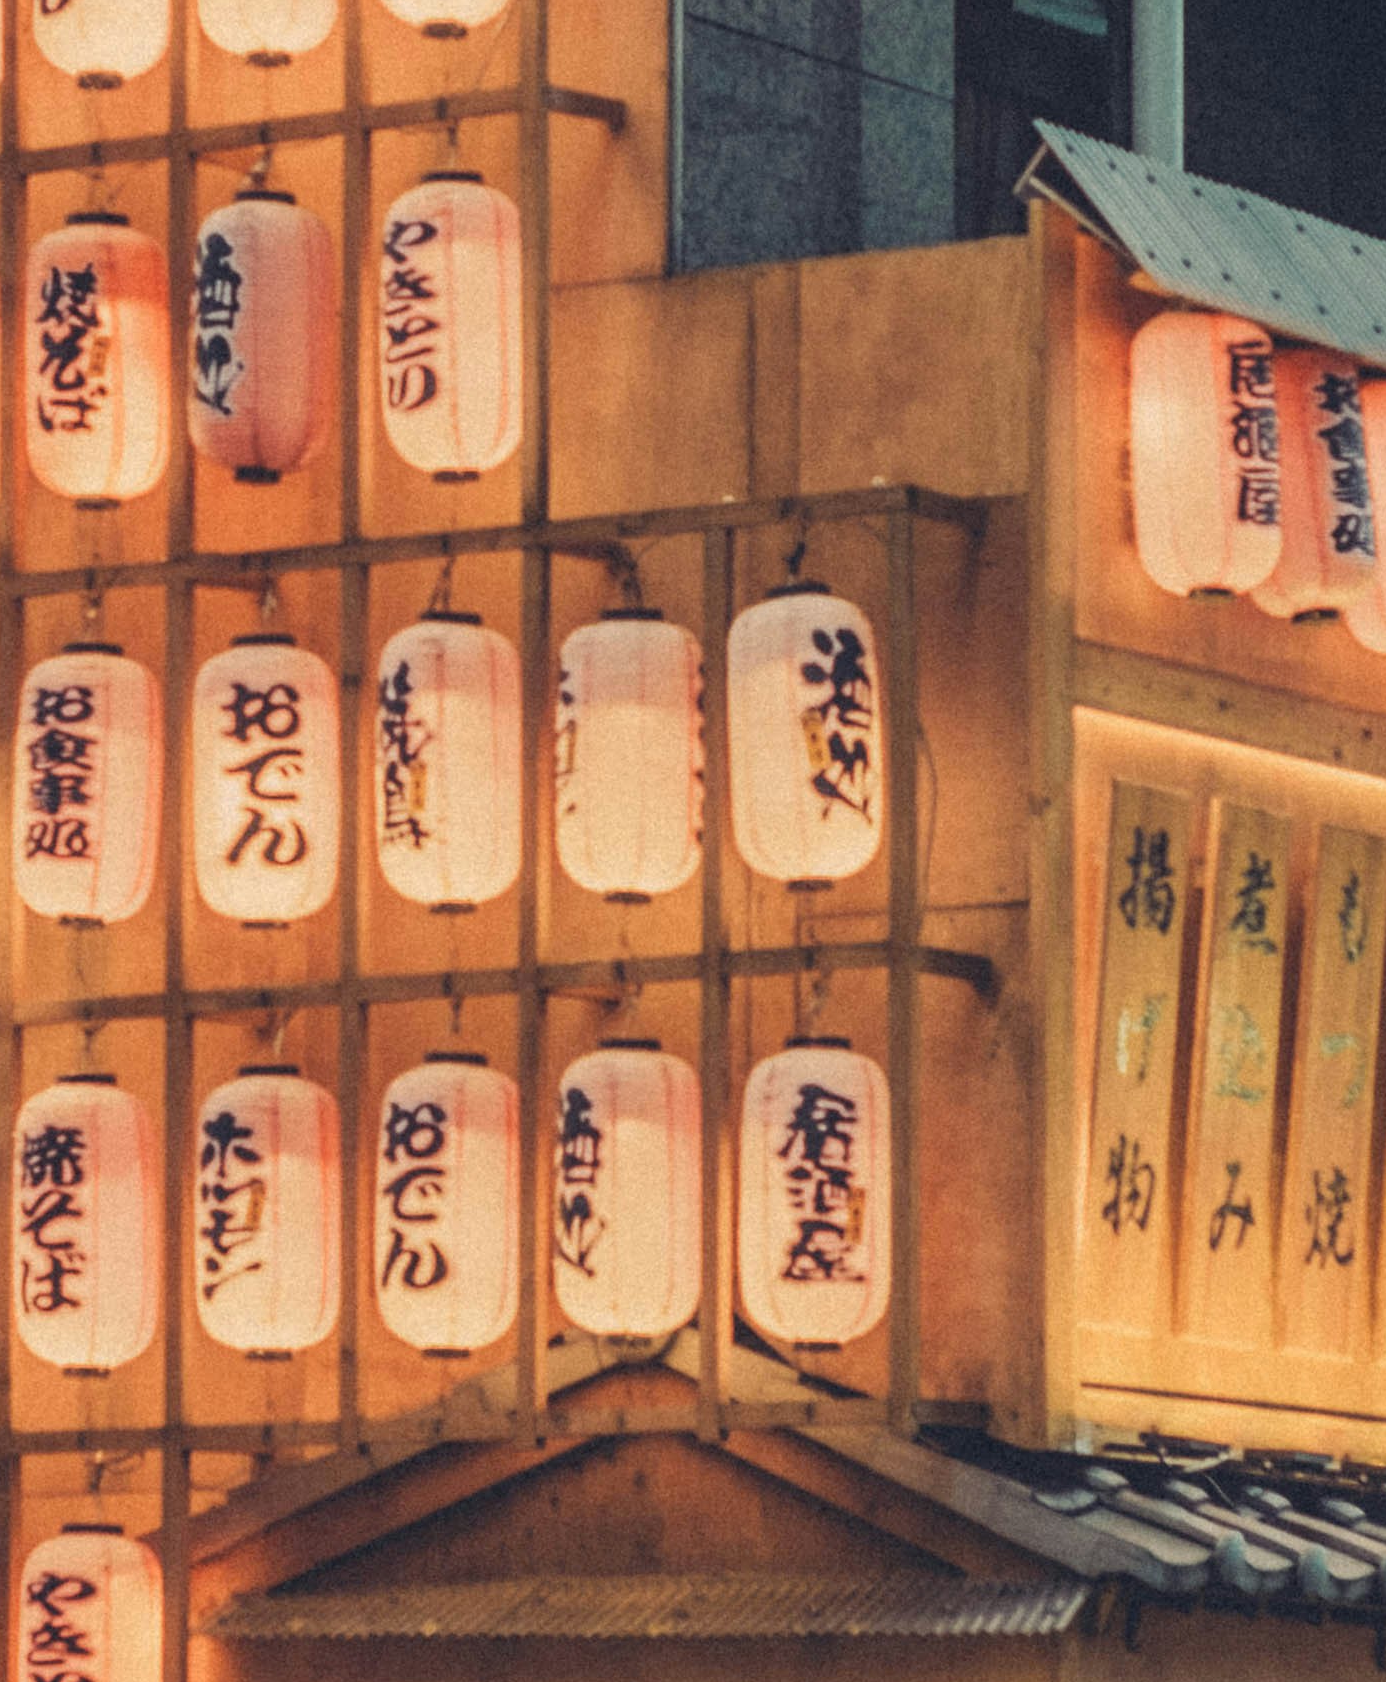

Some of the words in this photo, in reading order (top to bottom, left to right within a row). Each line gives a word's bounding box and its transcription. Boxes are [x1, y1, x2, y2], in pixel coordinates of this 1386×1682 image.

[384, 220, 439, 412] やきとり
[26, 684, 100, 861] お食事処
[221, 682, 309, 868] おでん
[201, 1111, 266, 1302] ホルモン
[382, 1101, 449, 1290] おでん
[776, 1083, 866, 1283] 居酒屋
